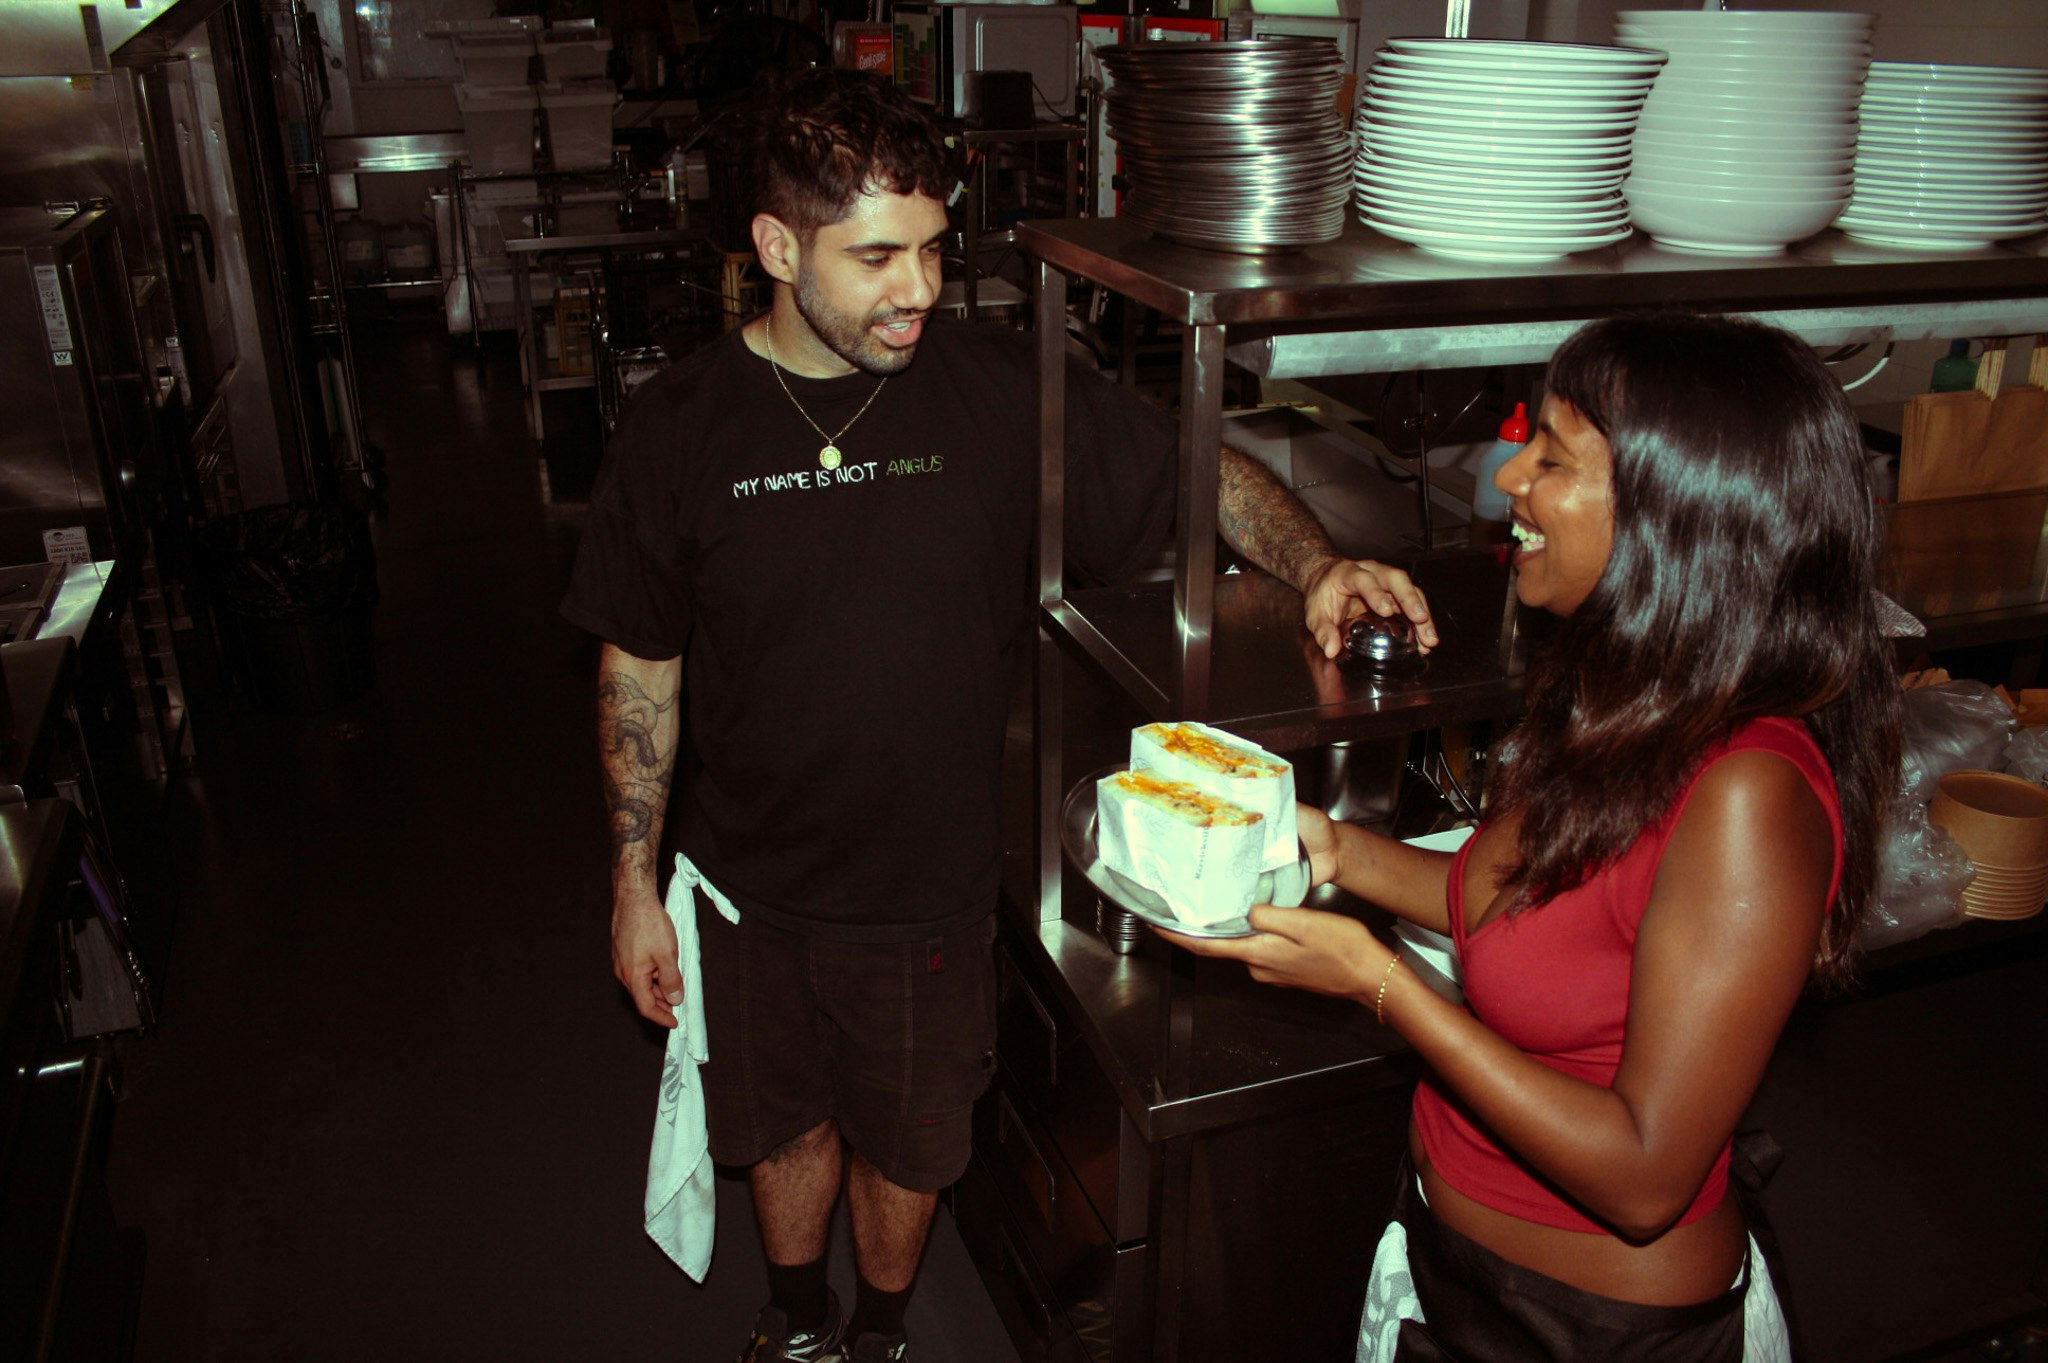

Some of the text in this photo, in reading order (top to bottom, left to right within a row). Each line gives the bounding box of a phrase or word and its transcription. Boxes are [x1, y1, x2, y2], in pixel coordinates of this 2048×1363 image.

[733, 455, 945, 498] MY NAME IS NOT ANGUS
